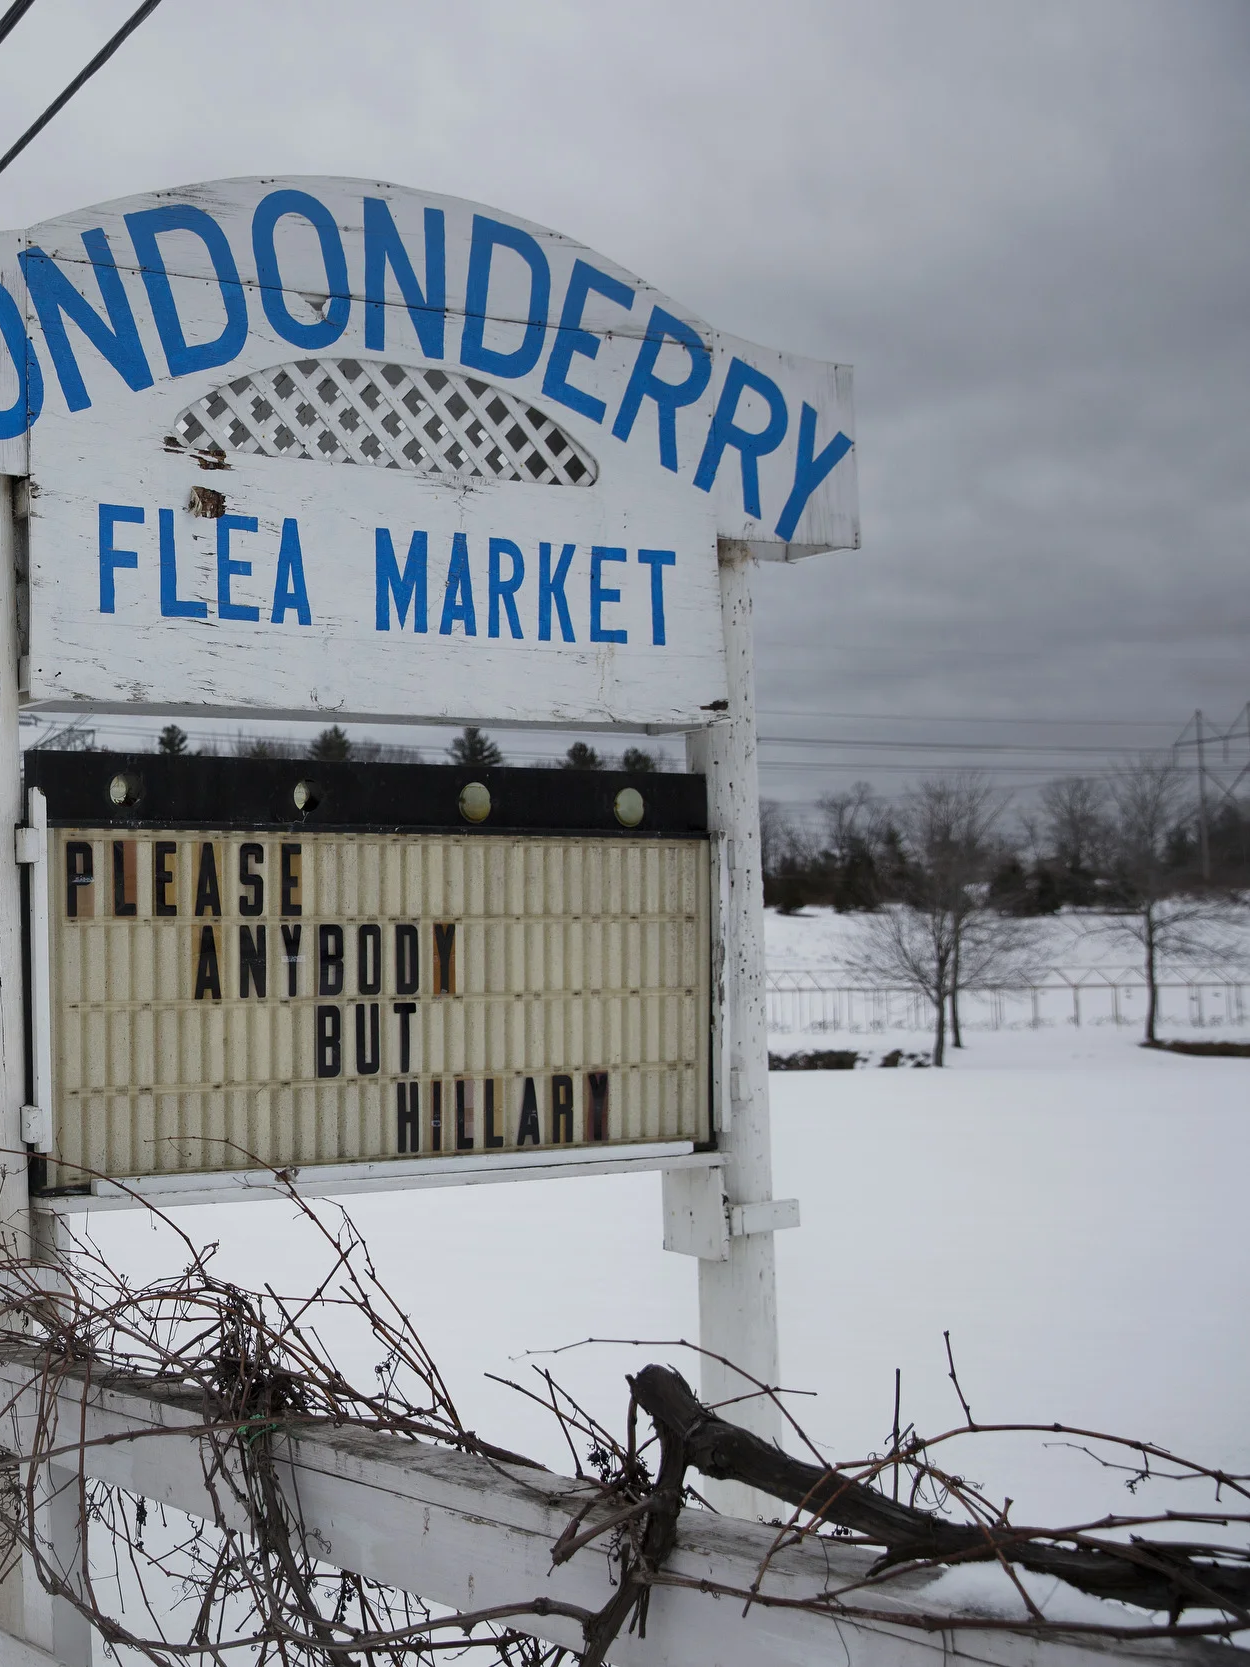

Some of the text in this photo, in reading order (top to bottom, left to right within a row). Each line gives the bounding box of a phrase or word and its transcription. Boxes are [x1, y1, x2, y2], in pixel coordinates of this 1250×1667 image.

[99, 503, 676, 647] FLEA MARKET
[66, 841, 302, 917] PLEASE
[195, 924, 456, 999] ANYBODY
[317, 1002, 417, 1078] BUT
[397, 1072, 609, 1153] HILLARY
